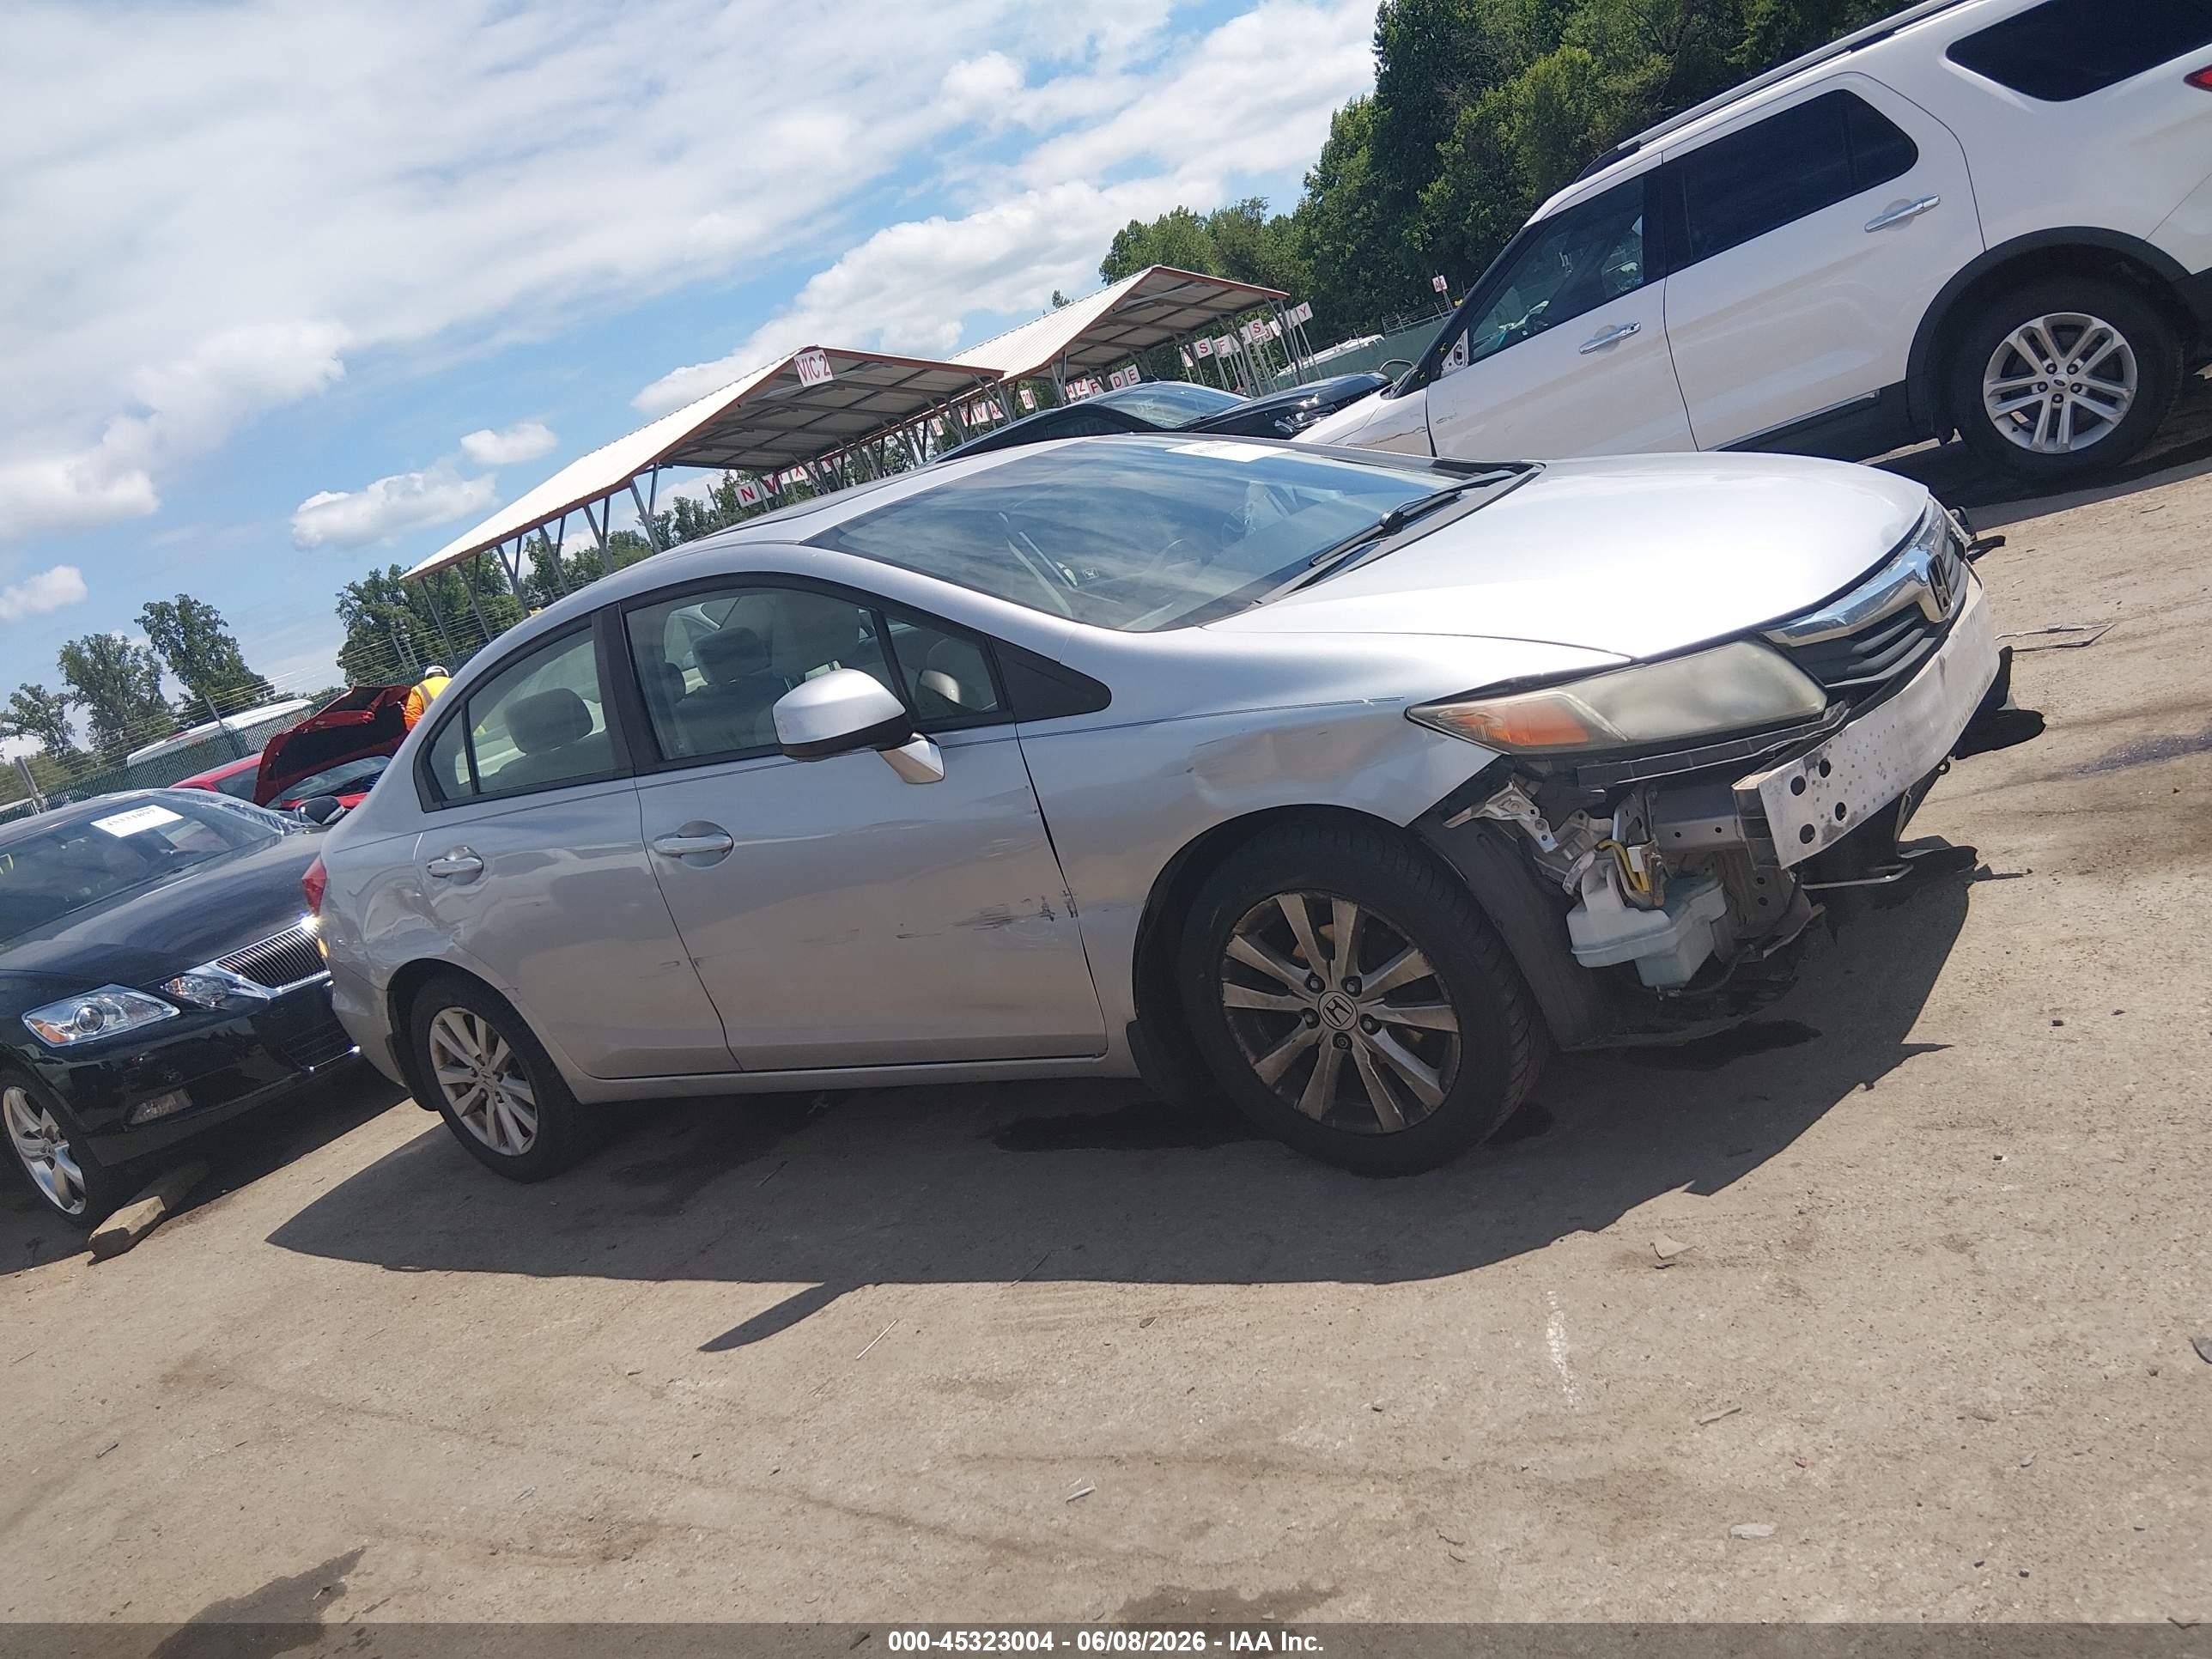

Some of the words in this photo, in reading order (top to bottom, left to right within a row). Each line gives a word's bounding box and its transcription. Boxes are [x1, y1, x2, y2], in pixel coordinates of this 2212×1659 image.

[1299, 306, 1307, 317] Y
[1252, 322, 1261, 334] S
[1199, 343, 1209, 354] S
[795, 356, 820, 381] VIC
[818, 354, 830, 376] 2
[1113, 375, 1122, 388] D
[1128, 369, 1137, 382] E
[1077, 380, 1086, 392] Z
[1090, 381, 1099, 394] F
[741, 486, 756, 502] N
